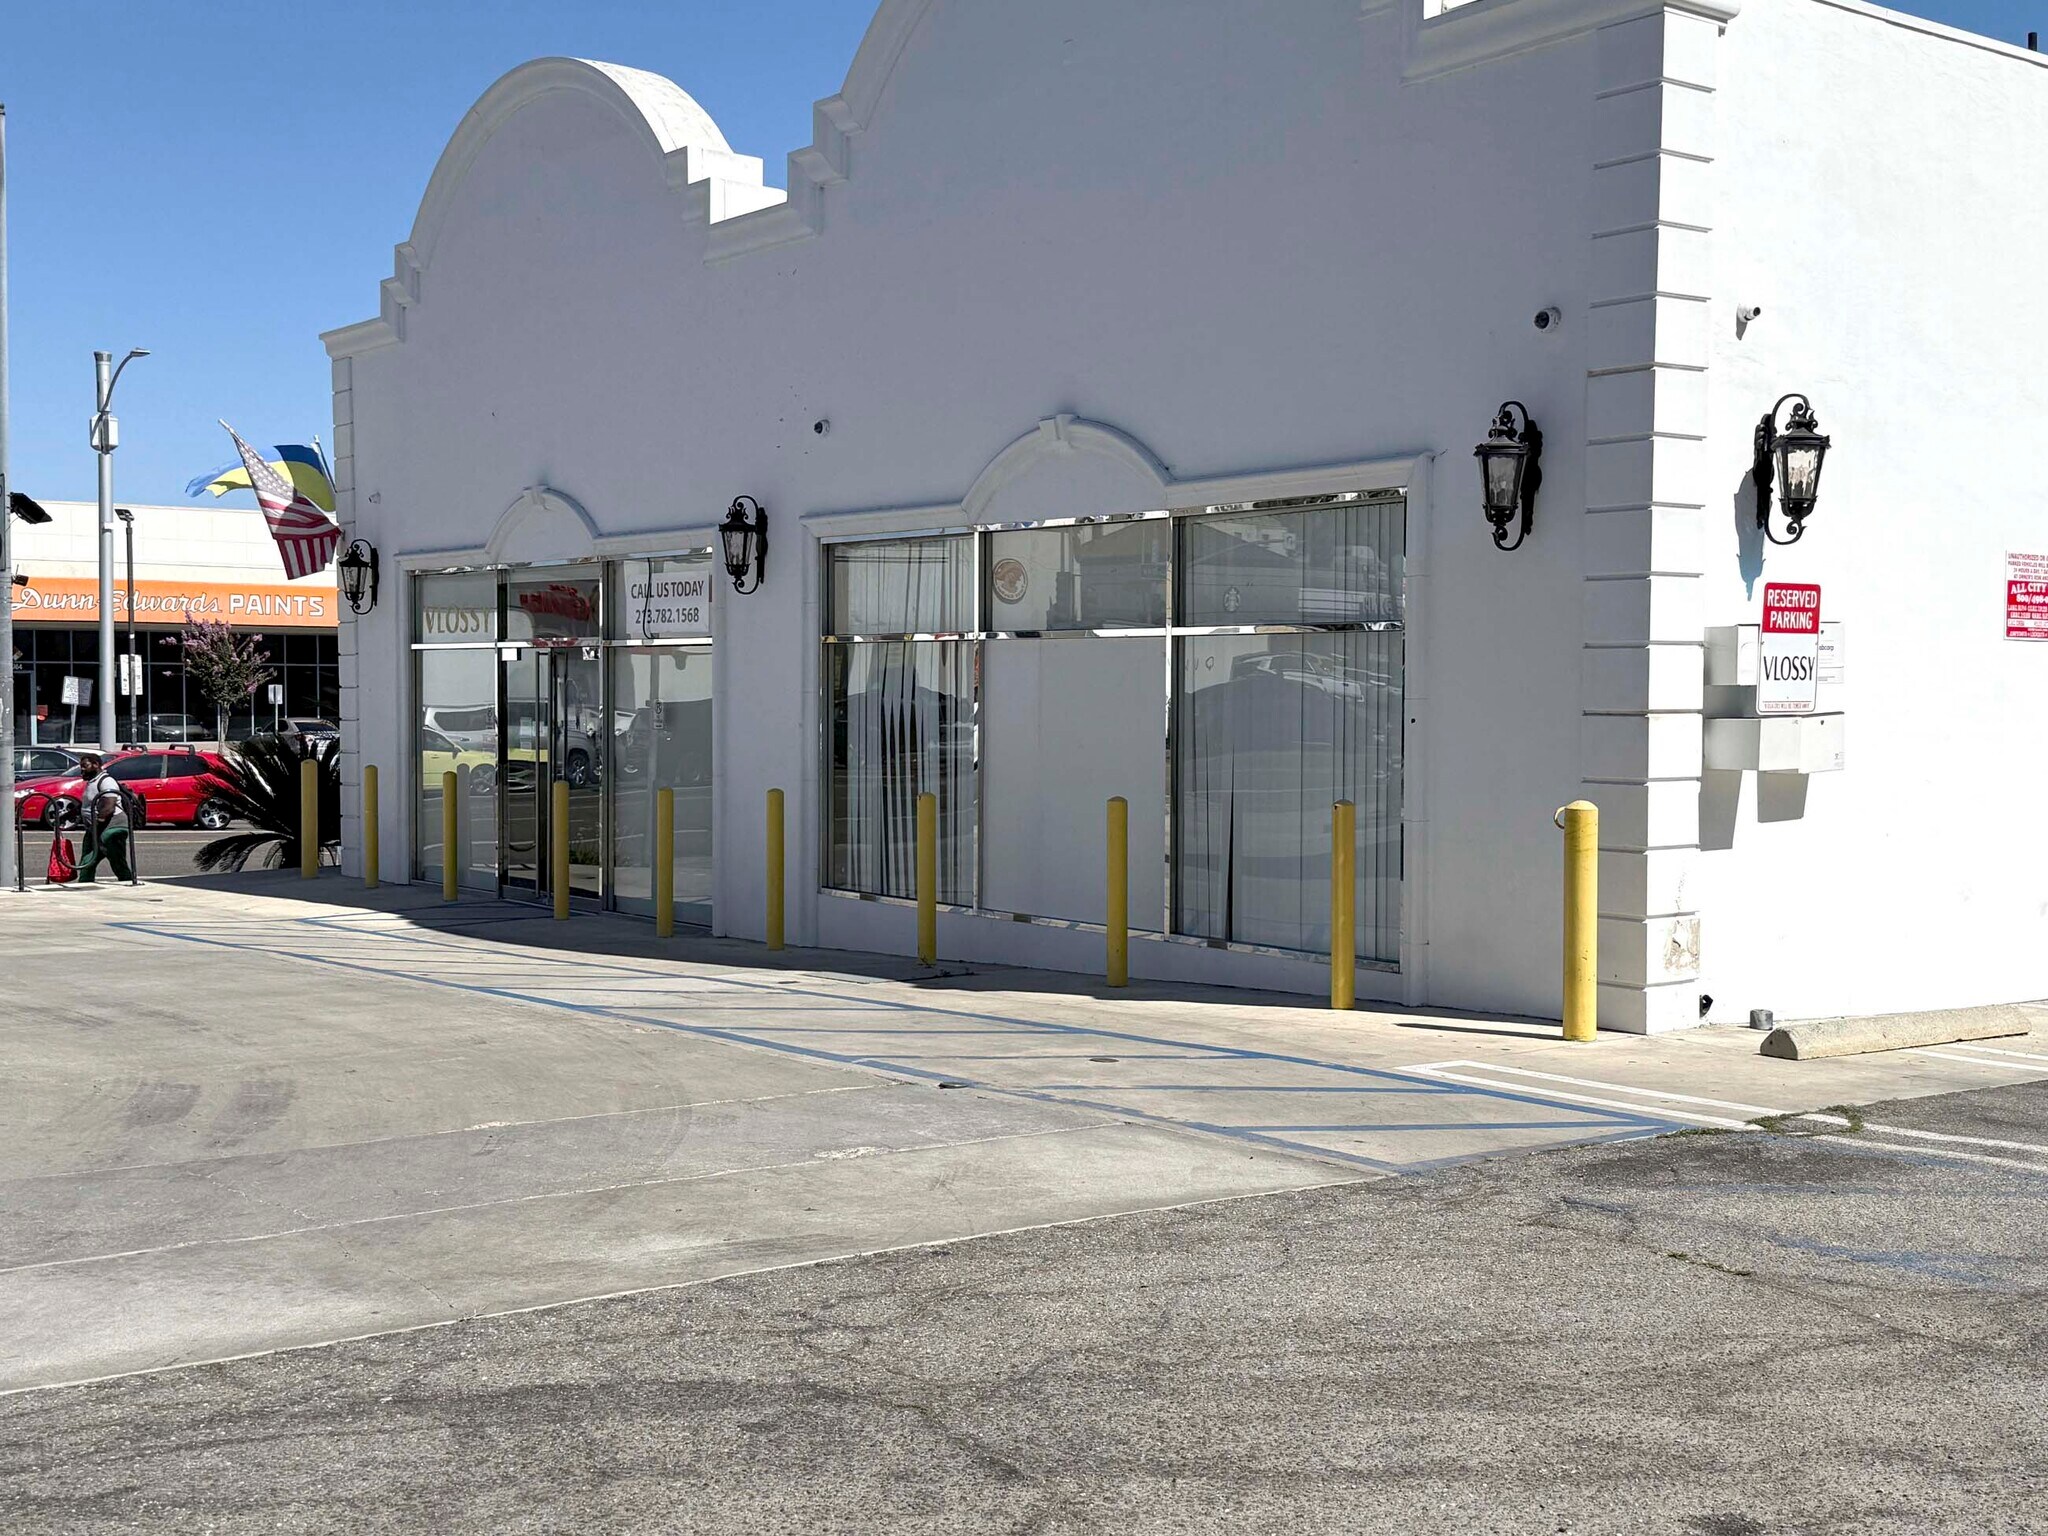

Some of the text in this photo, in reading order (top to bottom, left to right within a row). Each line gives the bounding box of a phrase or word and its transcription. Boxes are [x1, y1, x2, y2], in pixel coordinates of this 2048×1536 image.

[631, 580, 704, 599] CALL US TODAY
[2011, 582, 2047, 594] ALL CITY
[229, 594, 325, 617] PAINTS
[1767, 589, 1817, 609] RESERVED
[425, 606, 490, 634] VLOSSY
[1769, 611, 1813, 630] PARKING
[1818, 644, 1834, 652] abcorp
[1763, 655, 1815, 681] VLOSSY
